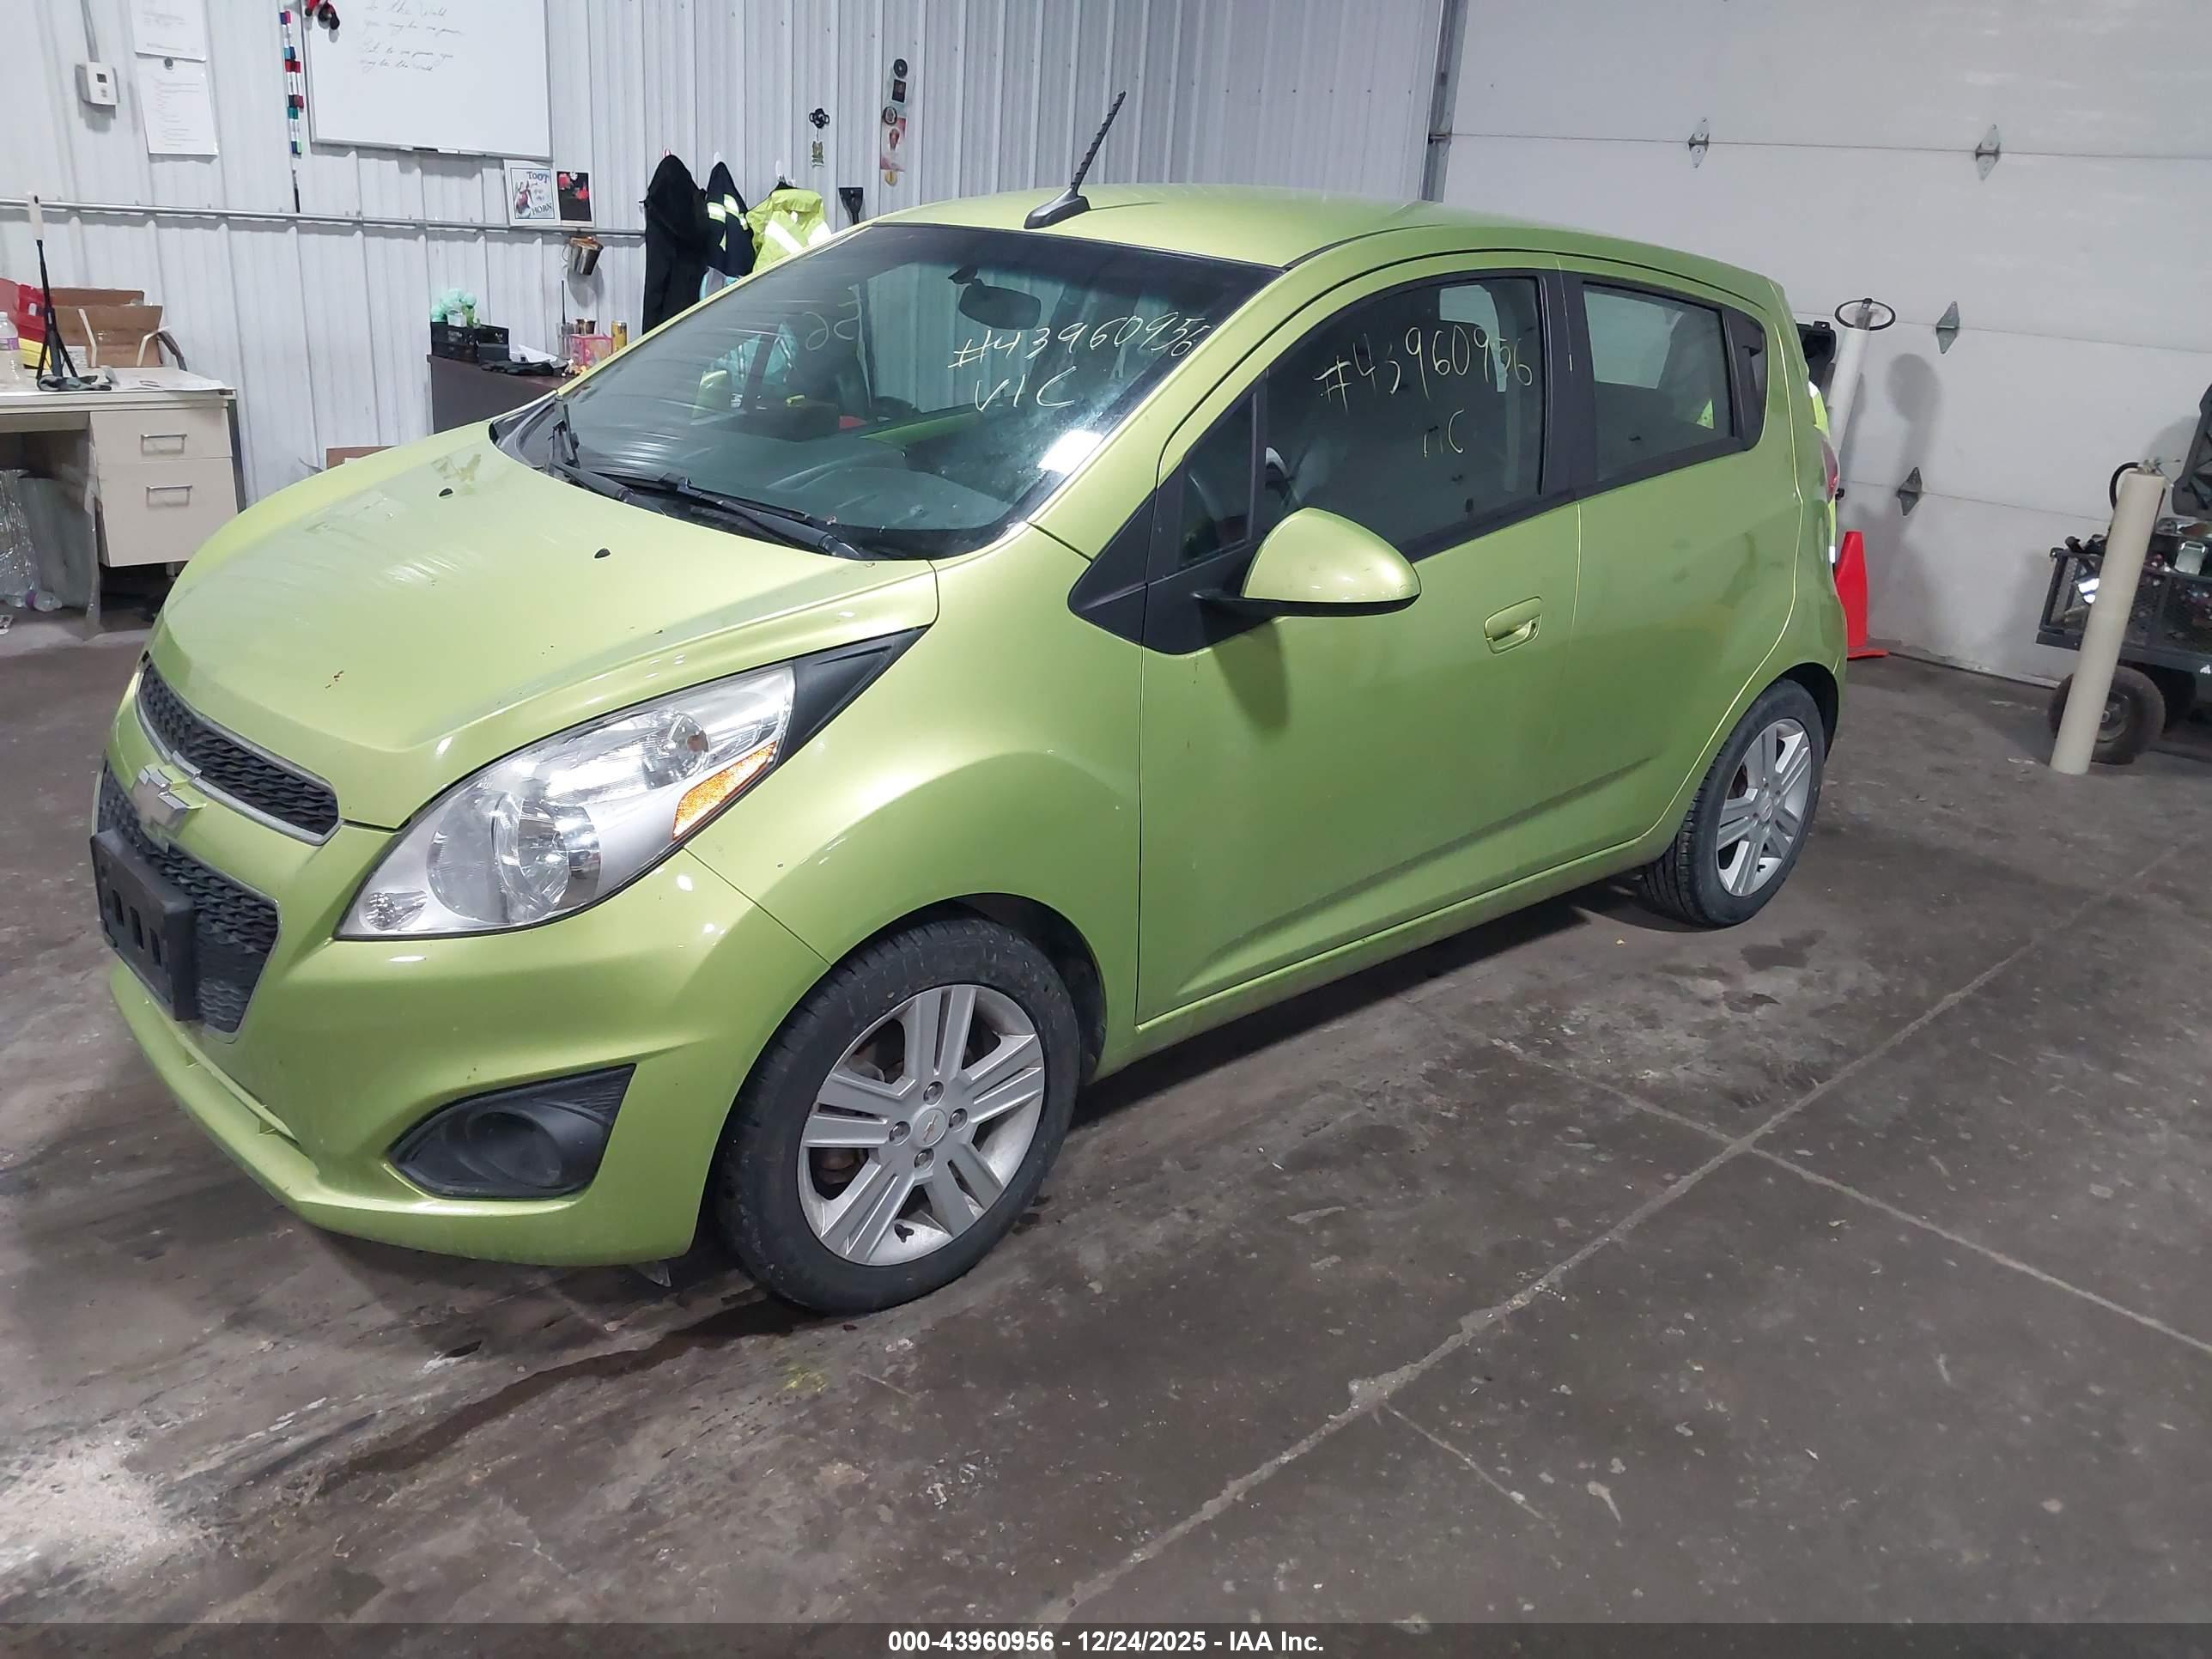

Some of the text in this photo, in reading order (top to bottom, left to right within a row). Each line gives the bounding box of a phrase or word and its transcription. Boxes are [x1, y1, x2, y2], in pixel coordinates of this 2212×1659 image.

[526, 171, 550, 184] TOOT
[531, 202, 552, 216] HORN
[947, 311, 1211, 368] #43960956
[975, 366, 1077, 412] VIC
